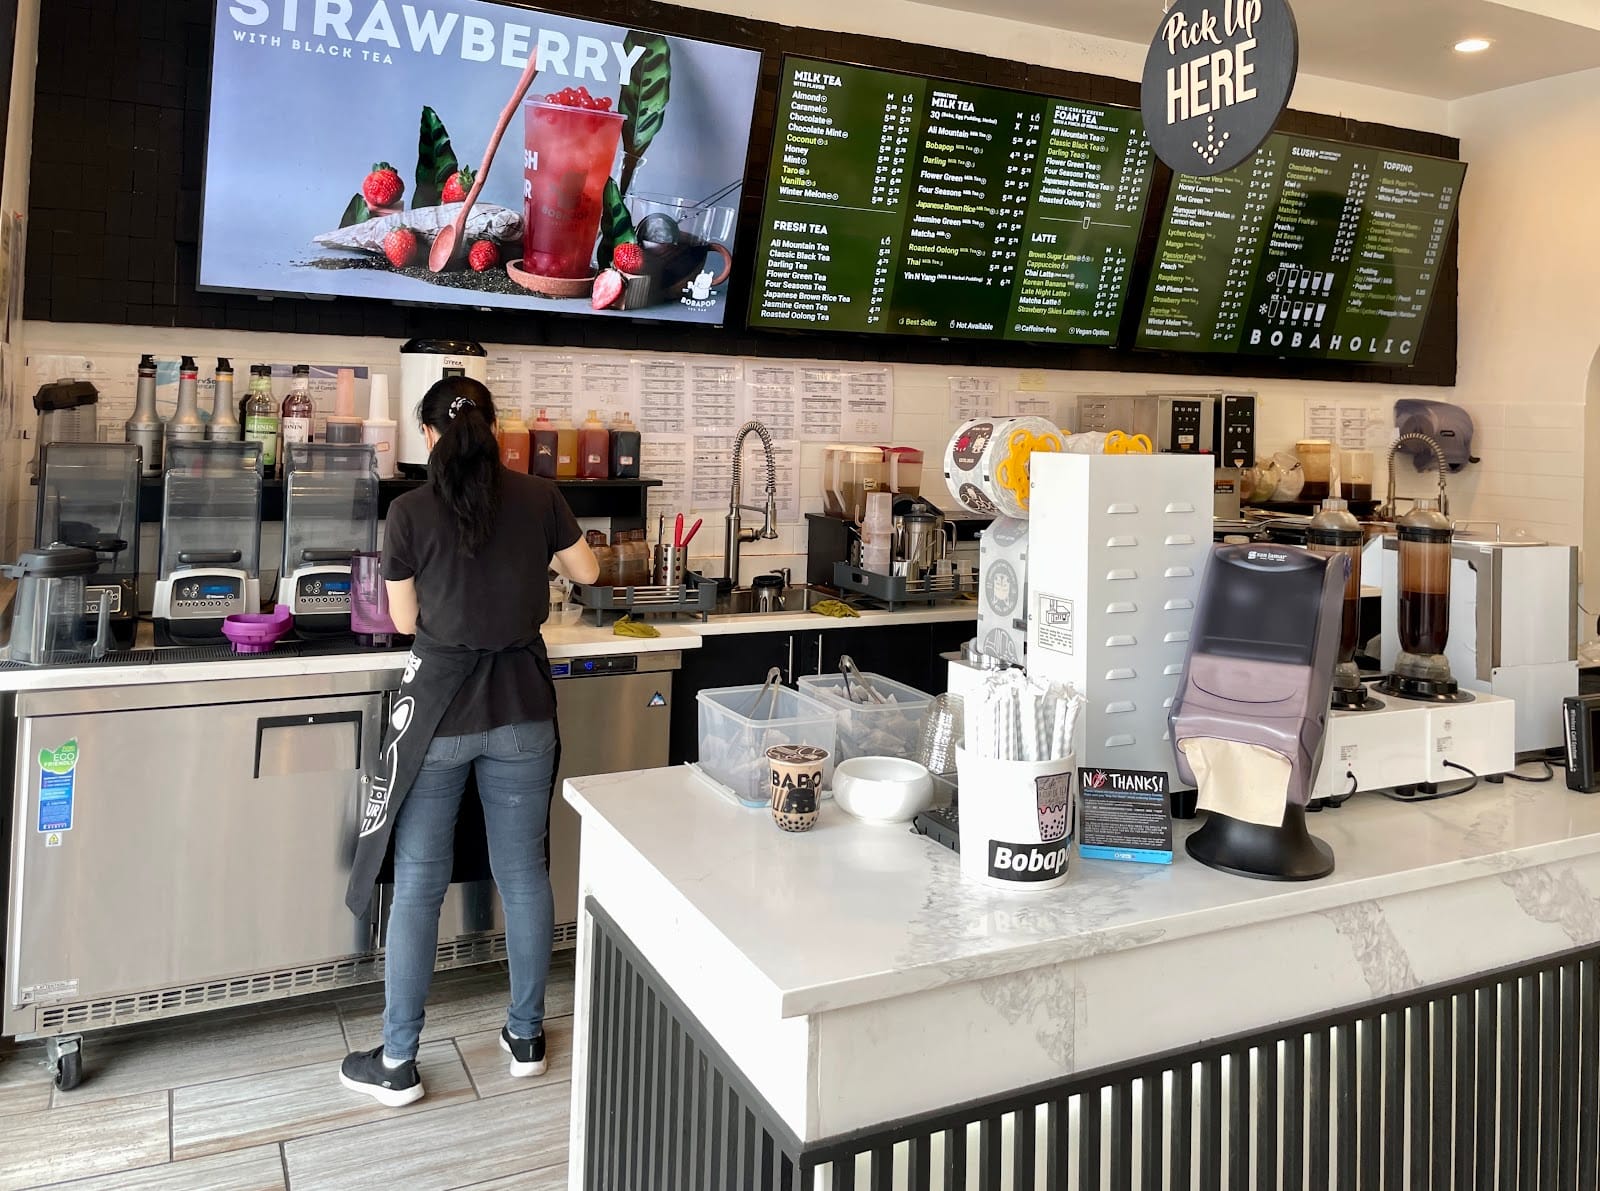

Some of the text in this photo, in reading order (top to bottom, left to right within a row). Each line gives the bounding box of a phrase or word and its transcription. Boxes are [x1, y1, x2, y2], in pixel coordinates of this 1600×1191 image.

[1162, 0, 1262, 55] Pick Up
[229, 0, 648, 86] STRAWBERRY
[233, 30, 393, 64] WITH BLACK TEA
[794, 71, 841, 86] MILK TEA
[1167, 38, 1257, 125] HERE
[792, 91, 821, 101] Almond
[791, 102, 821, 112] Caramel
[932, 98, 975, 112] MILK TEA
[789, 112, 826, 124] Chocolate
[930, 111, 940, 120] 3Q
[1054, 111, 1097, 124] FOAM TEA
[788, 123, 842, 137] Chocolate Mint
[938, 128, 969, 138] Mountain
[787, 134, 817, 144] Coconut
[785, 144, 809, 155] Honey
[925, 141, 954, 152] Bobapop
[1292, 147, 1315, 158] SLUSH
[783, 155, 801, 164] Mint
[923, 156, 946, 166] Darling
[783, 165, 799, 174] Taro
[1383, 161, 1413, 173] TOPPING
[781, 176, 805, 185] Vanilla
[920, 170, 963, 182] Flower Green
[780, 186, 827, 199] Winter Melon
[918, 185, 962, 197] Four Seasons
[774, 220, 828, 234] FRESH TEA
[1032, 233, 1056, 243] LATTE
[782, 241, 816, 250] Mountain
[817, 243, 829, 251] Tea
[769, 250, 830, 261] Classic Black Tea
[768, 259, 794, 270] Darling
[766, 270, 827, 281] Flower Green Tea
[765, 280, 826, 291] Four Seasons Tea
[681, 297, 716, 307] BOBAPOP
[763, 290, 851, 303] Japanese Brown Rice Tea
[762, 300, 828, 311] Jasmine Green Tea
[761, 310, 829, 321] Roasted Oolong Tea
[54, 752, 74, 761] ECO
[1109, 774, 1163, 792] THANKS!
[994, 846, 1071, 874] Bobap
